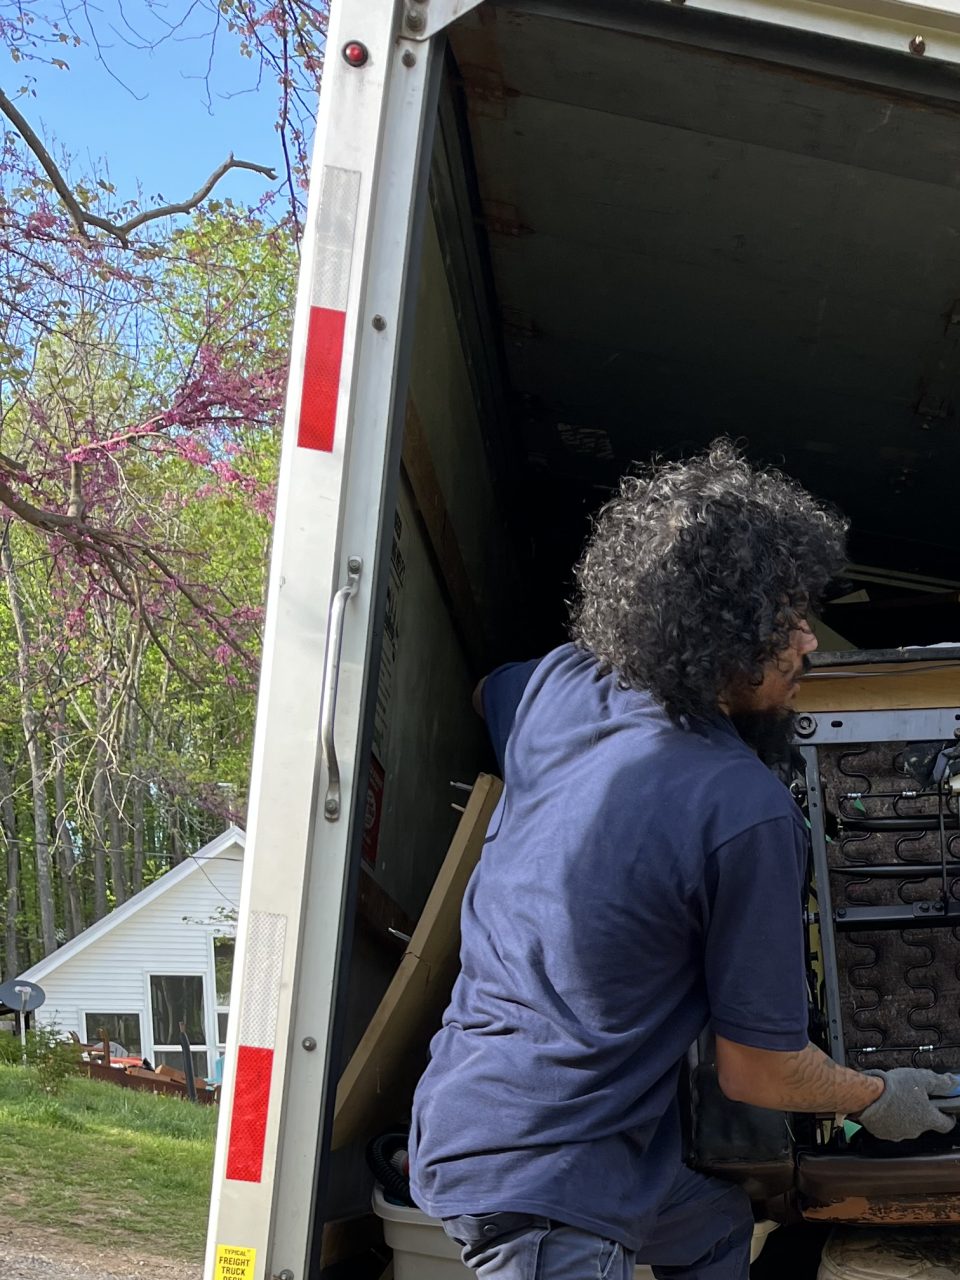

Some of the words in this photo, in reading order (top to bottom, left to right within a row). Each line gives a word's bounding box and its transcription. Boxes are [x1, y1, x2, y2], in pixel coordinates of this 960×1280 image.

[224, 1248, 247, 1257] TYPICAL
[218, 1256, 250, 1267] FREIGHT
[221, 1266, 246, 1276] TRUCK
